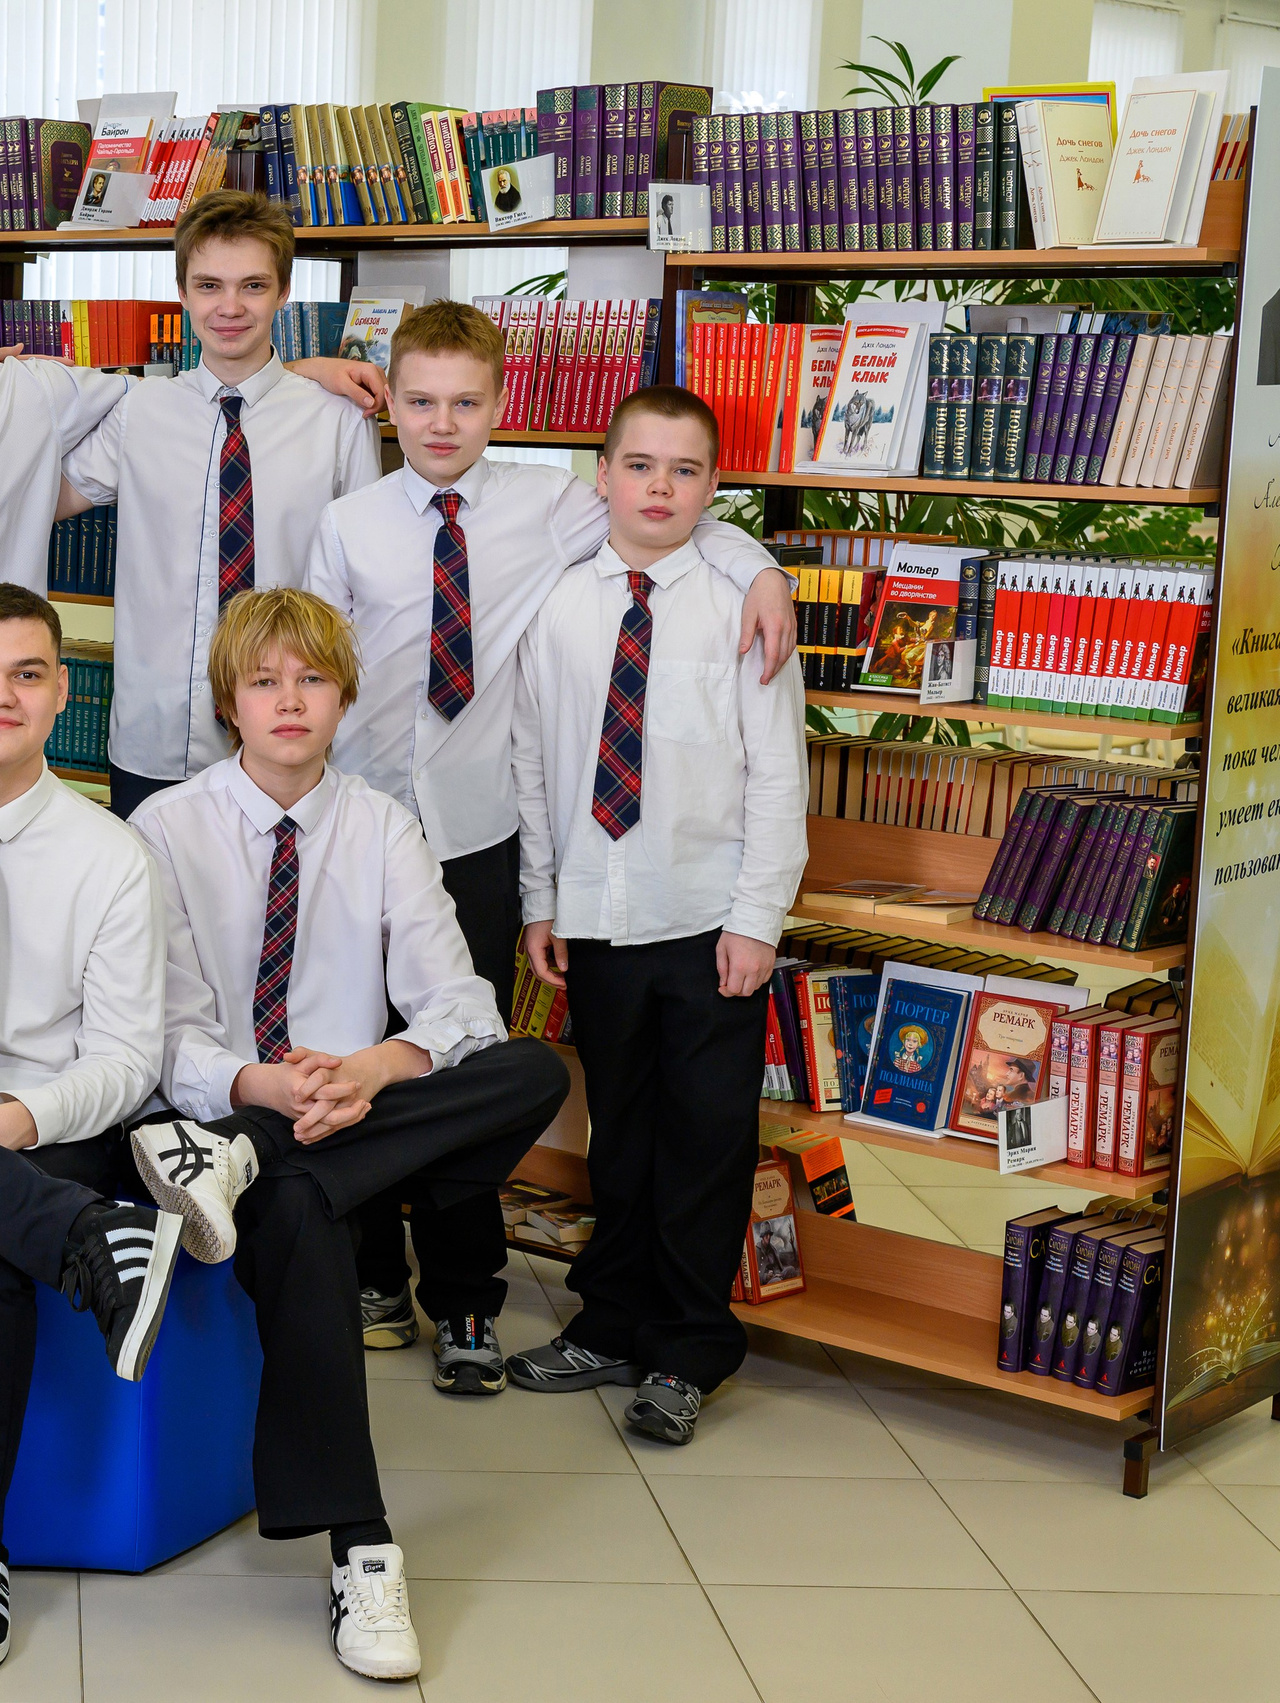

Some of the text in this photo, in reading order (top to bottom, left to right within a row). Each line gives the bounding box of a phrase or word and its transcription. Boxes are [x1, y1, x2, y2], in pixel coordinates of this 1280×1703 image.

[101, 127, 130, 138] Байрон
[425, 122, 437, 154] ГОЛДИНГ
[440, 121, 452, 153] ГОЛДИНГ
[1056, 137, 1103, 148] Дочь снегов
[1129, 127, 1177, 140] Дочь снегов
[1059, 154, 1105, 164] Джек Лондон
[1126, 145, 1172, 156] Джек Лондон
[943, 175, 951, 210] ЛОНДОН
[982, 170, 990, 203] ЛОНДОН
[494, 214, 513, 223] Виктор
[851, 352, 898, 368] БЕЛЫЙ
[851, 370, 890, 384] КЛЫК
[952, 407, 967, 466] ЛОНДОН
[1004, 408, 1022, 468] ЛОНДОН
[896, 561, 940, 578] Мольер
[890, 589, 937, 601] во дворянстве
[892, 581, 925, 591] Мещанин
[980, 627, 988, 657] МОЛЬЕР
[992, 629, 1005, 665] Мольер
[1018, 632, 1031, 668] Мольер
[1045, 634, 1059, 670] Мольер
[1089, 638, 1104, 675] Мольер
[1119, 639, 1133, 676] Мольер
[1222, 743, 1280, 772] пока че
[1216, 801, 1264, 837] умеет
[1214, 852, 1280, 886] пользова
[893, 1000, 950, 1026] ПОРТЕР
[992, 1011, 1036, 1030] РЕМАРК
[878, 1070, 934, 1094] ПОЛЛИАННА
[1069, 1092, 1081, 1140] РЕМАРК
[1097, 1094, 1109, 1144] РЕМАРК
[1120, 1099, 1133, 1154] РЕМАРК
[364, 1564, 383, 1572] Tiger
